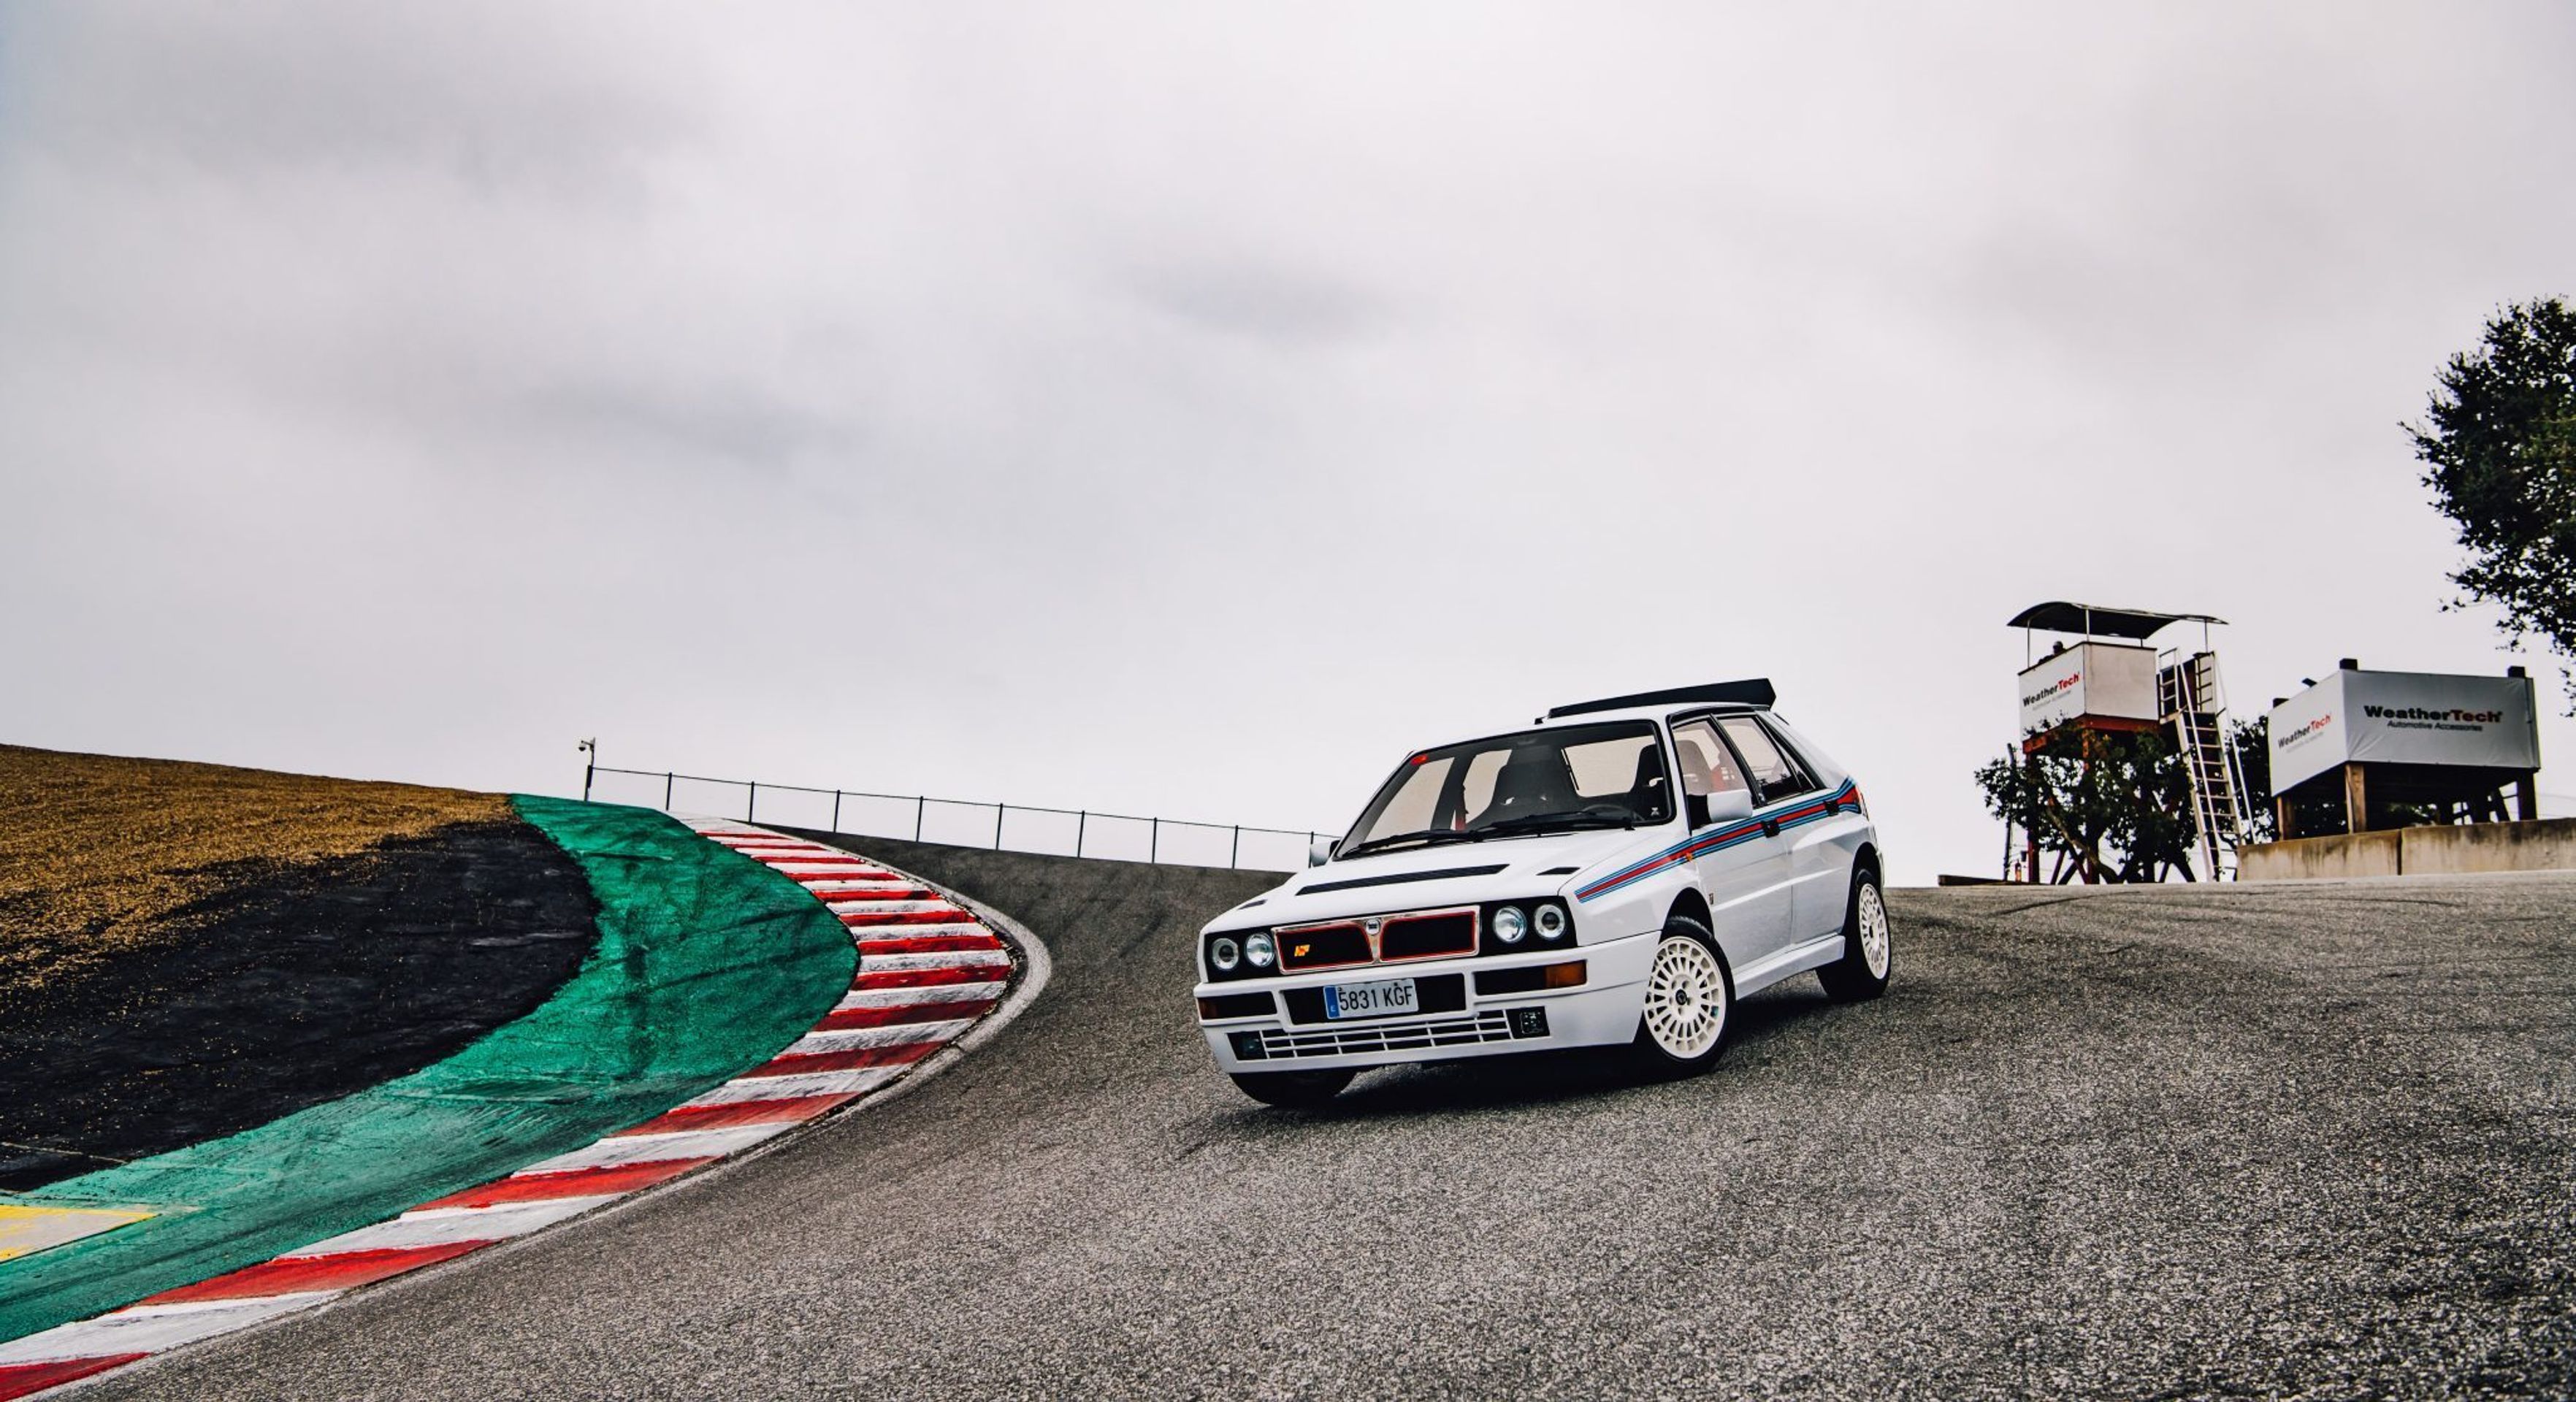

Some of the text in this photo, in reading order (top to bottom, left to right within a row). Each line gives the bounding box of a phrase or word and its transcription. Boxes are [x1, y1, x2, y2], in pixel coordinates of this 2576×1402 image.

[2022, 673, 2079, 707] WeatherTech
[2363, 705, 2501, 723] WeatherTech
[2278, 714, 2331, 748] WeatherTech
[1338, 985, 1413, 1011] 5831 KGF
